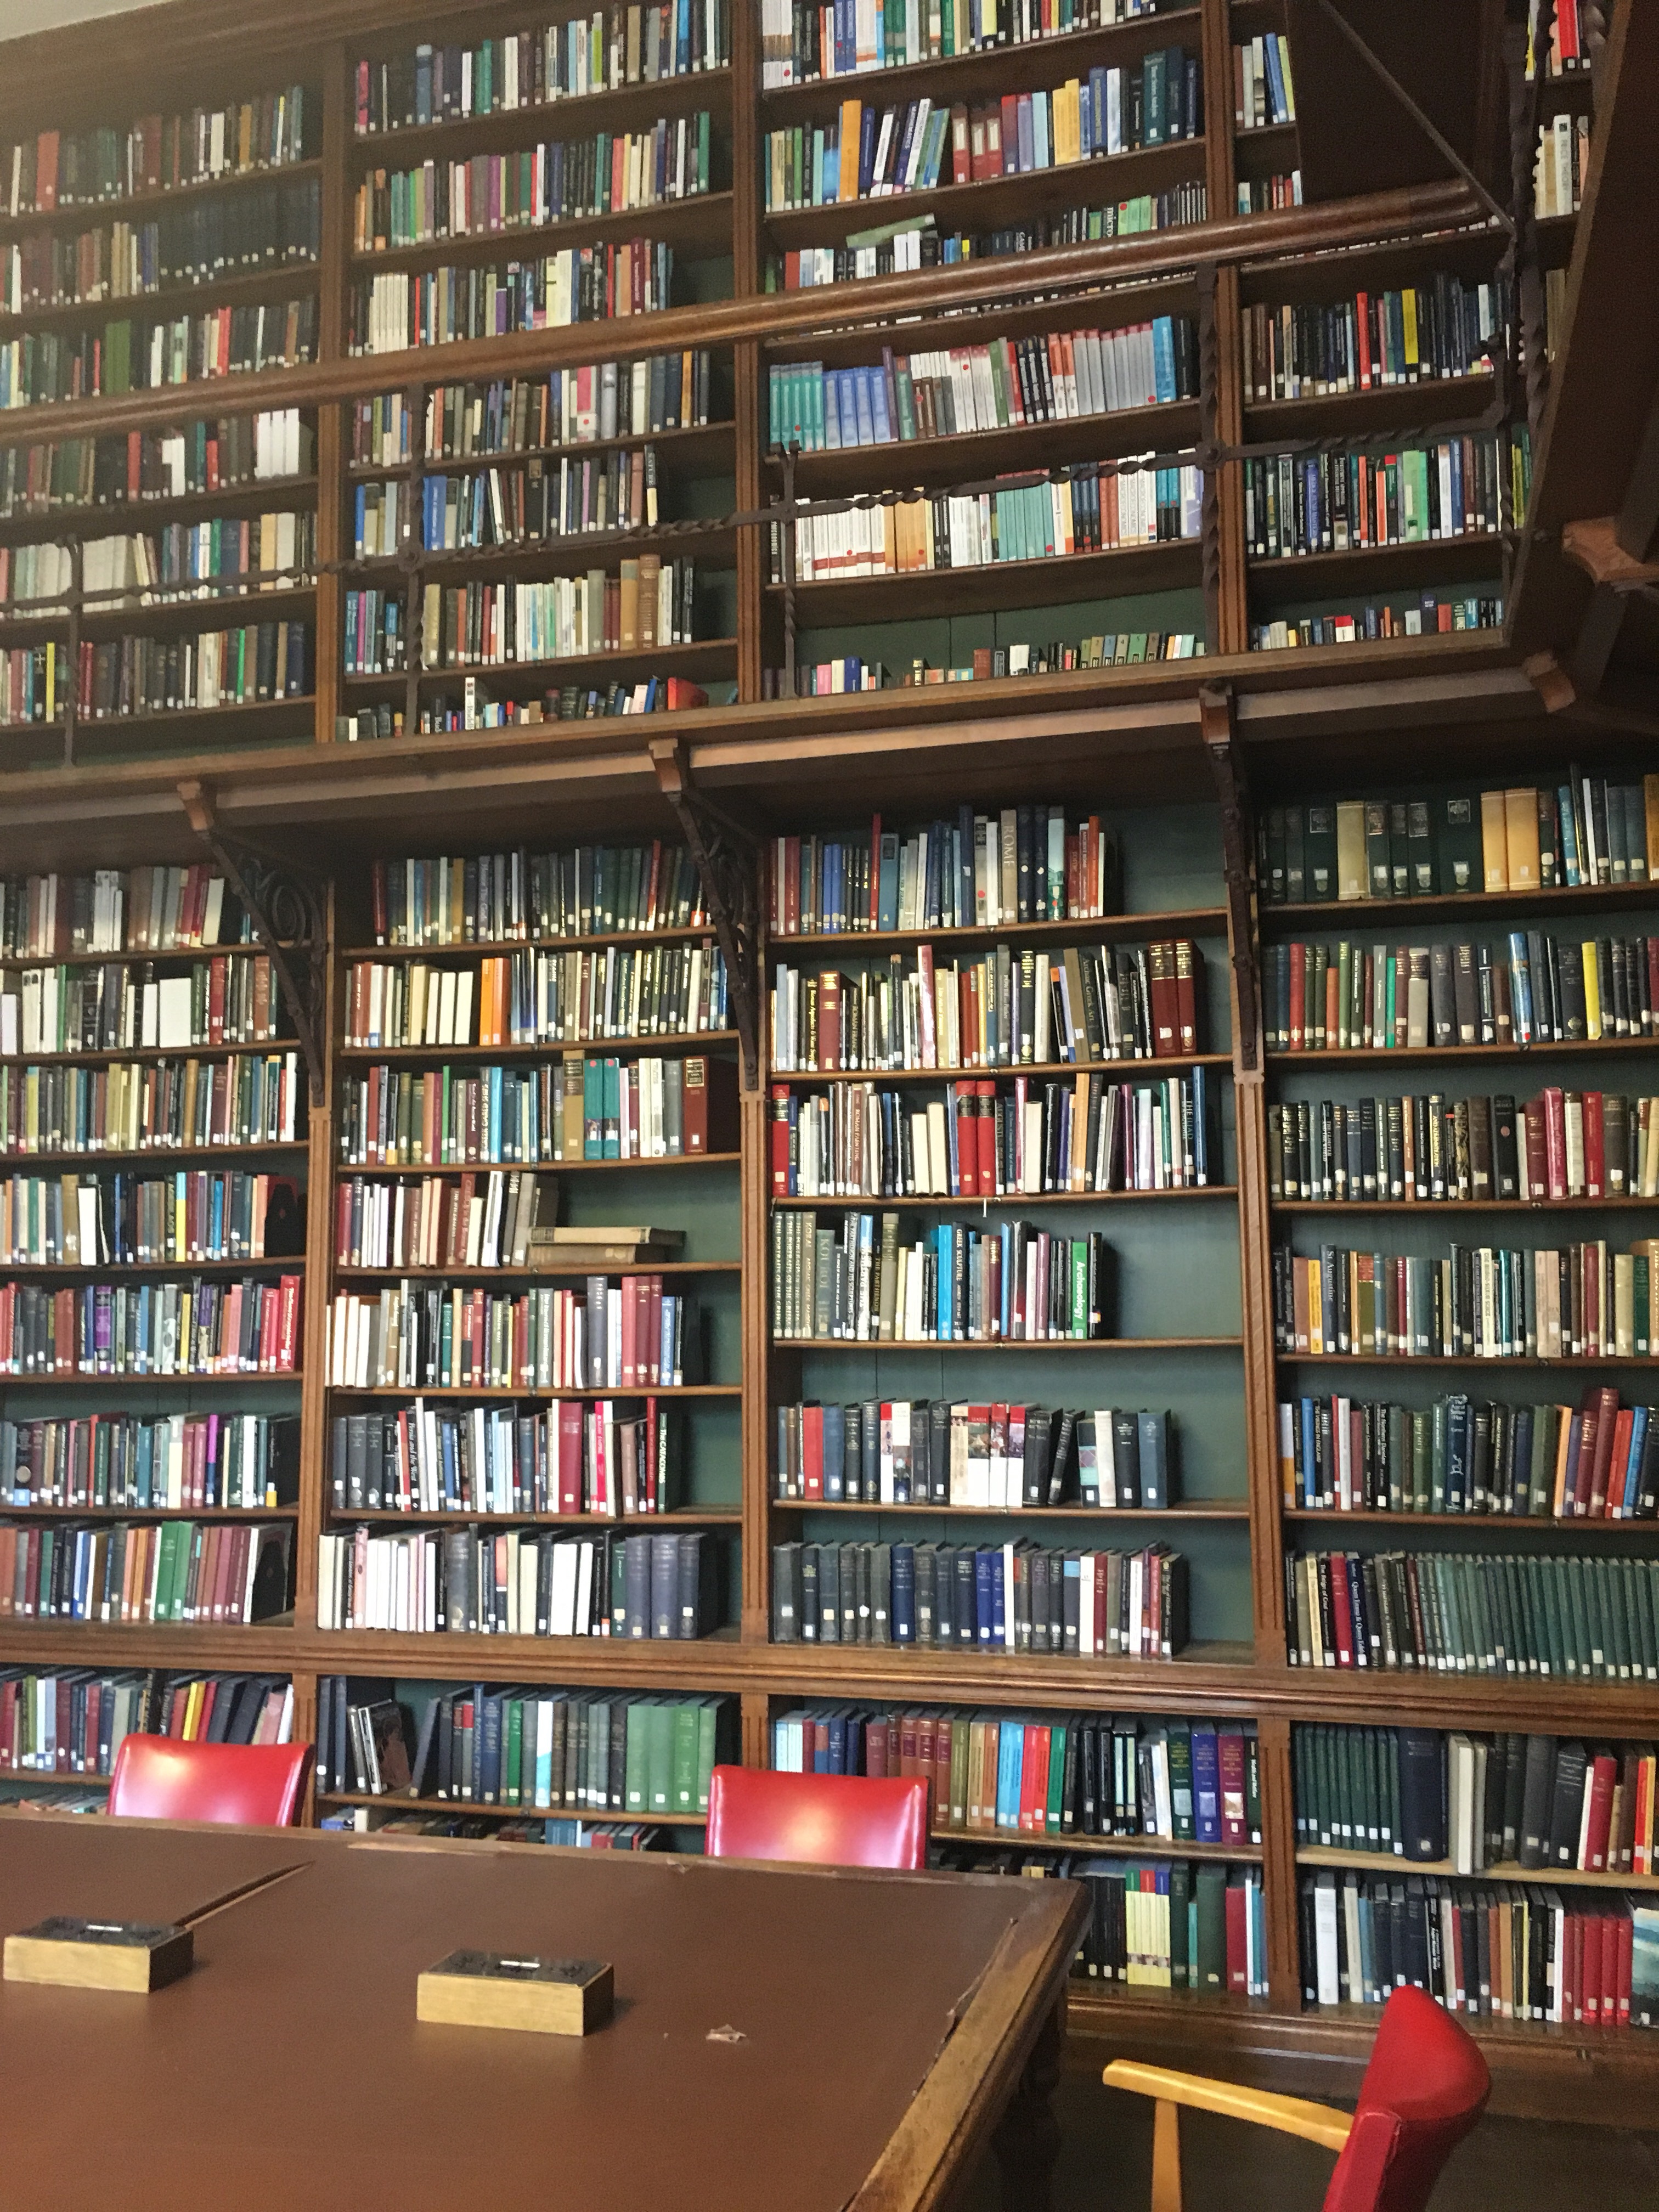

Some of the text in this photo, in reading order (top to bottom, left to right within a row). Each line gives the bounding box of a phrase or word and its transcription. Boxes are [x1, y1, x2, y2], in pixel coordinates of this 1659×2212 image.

[1003, 825, 1015, 867] ROME
[1086, 986, 1094, 1007] Greek
[1074, 1261, 1086, 1319] Archaeology
[1325, 1250, 1335, 1302] St Augustine
[1351, 1581, 1359, 1599] Queen
